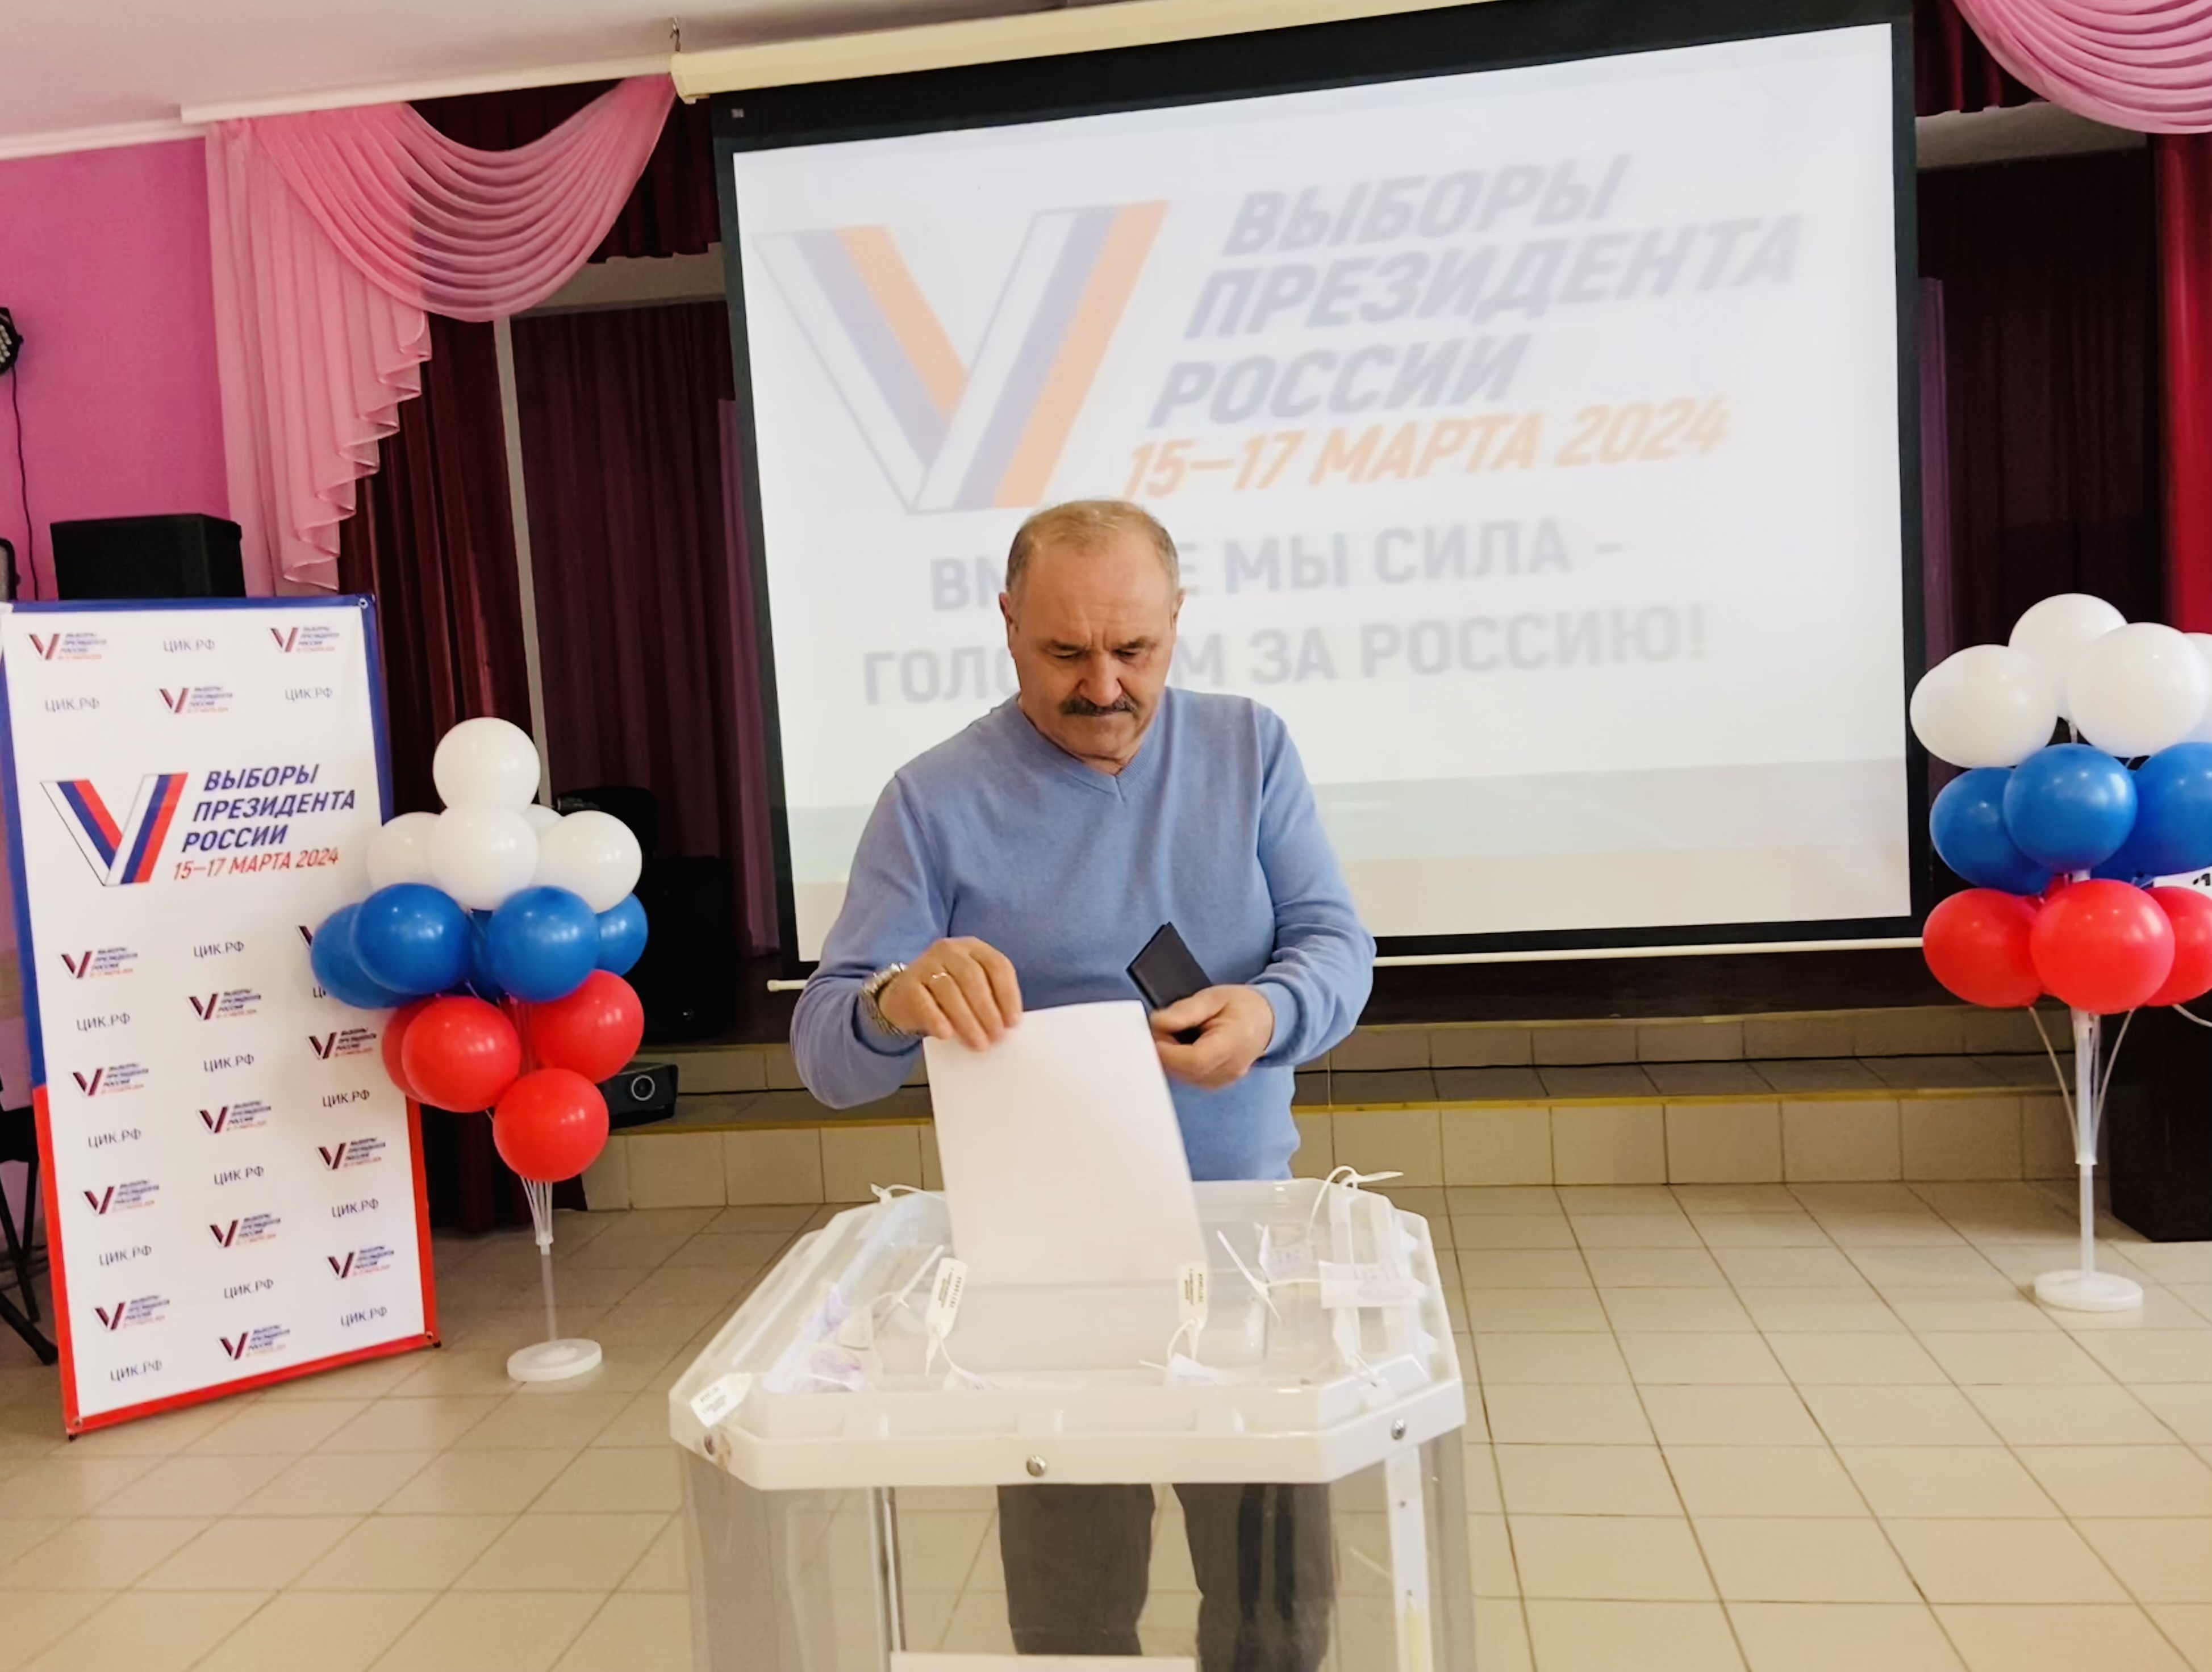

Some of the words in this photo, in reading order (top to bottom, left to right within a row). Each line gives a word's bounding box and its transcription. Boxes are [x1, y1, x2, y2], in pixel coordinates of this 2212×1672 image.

[1222, 153, 1633, 257] ВЫБОРЫ
[1184, 213, 1802, 340] ПРЕЗИДЕНТА
[1147, 333, 1532, 428] РОССИИ
[1308, 411, 1544, 486] МАРТА
[1554, 395, 1729, 467] 2024
[1224, 532, 1347, 594] МЫ
[1375, 517, 1572, 584] СИЛА
[1248, 625, 1338, 683] ЗА
[1360, 604, 1705, 678] РОССИЮ!
[203, 764, 320, 791] ВЫБОРЫ
[193, 789, 356, 822] ПРЕЗИДЕНТА
[181, 825, 289, 852] РОССИИ
[229, 852, 291, 875] МАРТА
[296, 847, 339, 868] 2024
[194, 941, 244, 958] ЦИК.РФ
[77, 1013, 130, 1031] ЦИК.РФ
[204, 1054, 254, 1072] ЦИК.РФ
[323, 1089, 370, 1107] ЦИК.РФ
[89, 1128, 141, 1148] ЦИК.РФ
[214, 1166, 264, 1185] ЦИК.РФ
[332, 1198, 378, 1218] ЦИК.РФ
[99, 1245, 152, 1266] ЦИК.РФ
[224, 1279, 273, 1299] ЦИК.РФ
[341, 1307, 387, 1327] ЦИК.РФ
[110, 1360, 162, 1381] ЦИК.РФ
